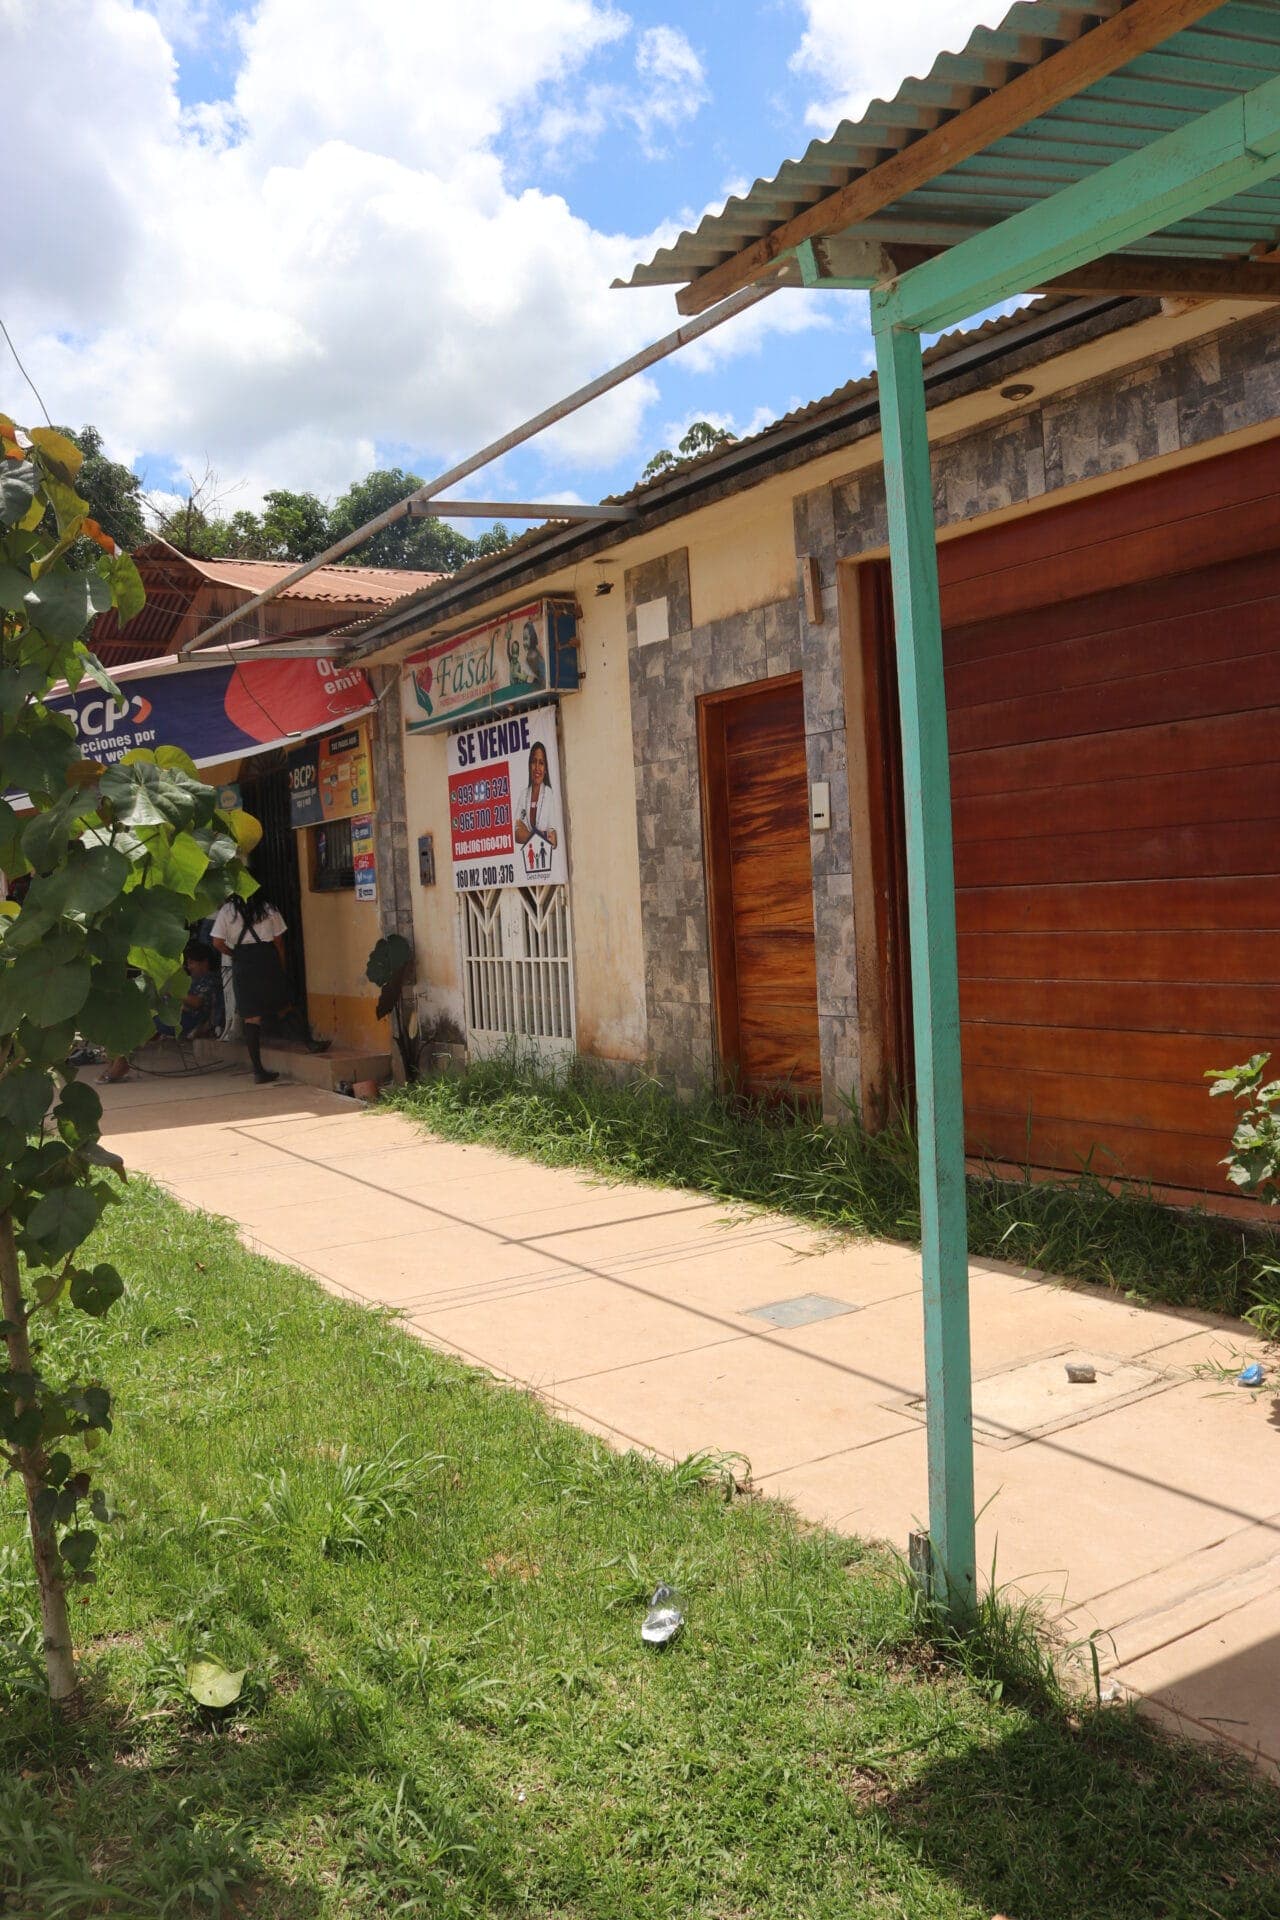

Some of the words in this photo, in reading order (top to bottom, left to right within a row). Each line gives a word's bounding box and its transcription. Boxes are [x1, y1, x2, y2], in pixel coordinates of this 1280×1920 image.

[435, 629, 500, 698] Fasal
[60, 697, 130, 736] BCP
[80, 734, 132, 754] cciones
[134, 729, 156, 746] por
[457, 733, 476, 767] SE
[477, 716, 531, 762] VENDE
[293, 765, 312, 790] BCP
[457, 783, 473, 806] 993
[491, 775, 509, 799] 324
[460, 810, 475, 833] 965
[494, 804, 510, 825] 201
[456, 870, 469, 888] 160
[469, 868, 480, 887] M2
[482, 865, 497, 886] COD
